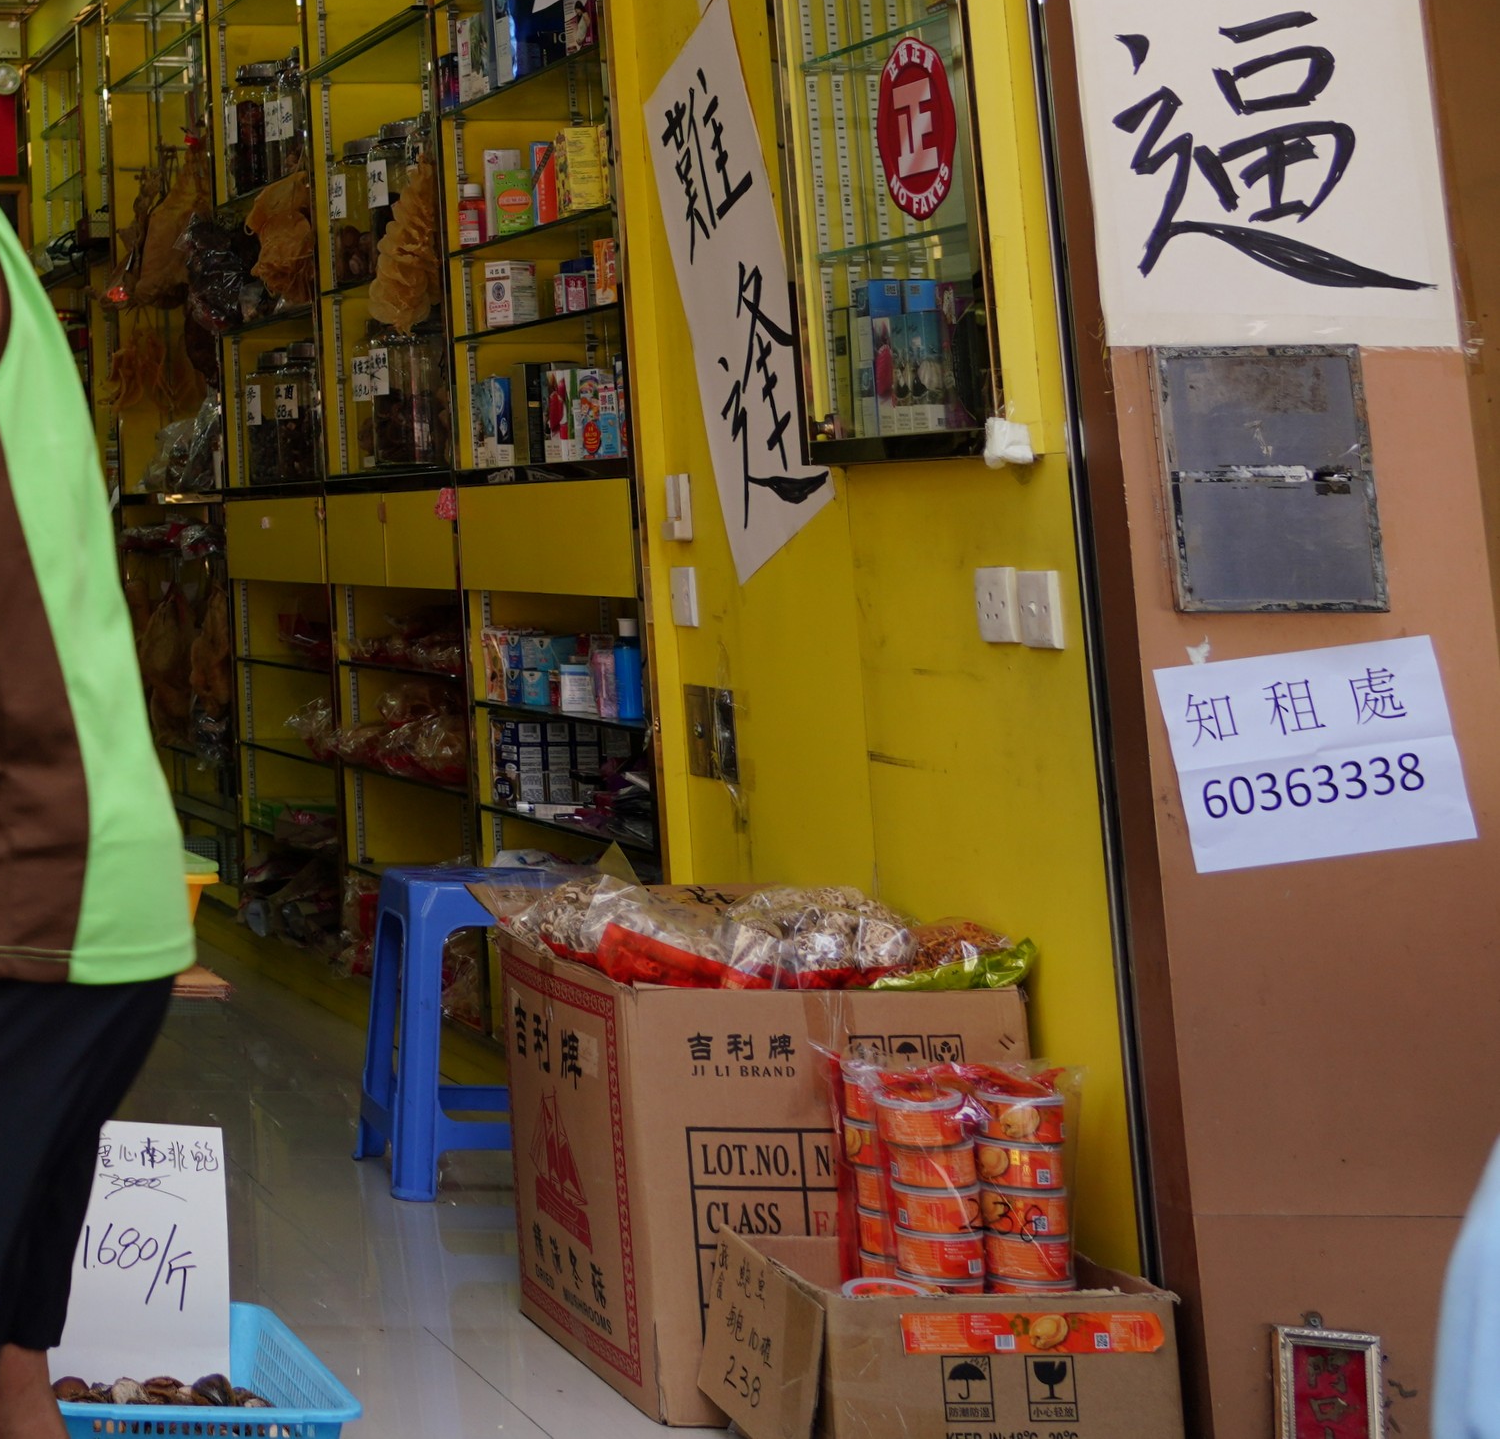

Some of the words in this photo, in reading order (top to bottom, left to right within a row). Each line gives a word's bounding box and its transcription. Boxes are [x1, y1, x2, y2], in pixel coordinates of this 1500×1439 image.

[891, 77, 939, 179] 正
[889, 172, 907, 207] NO
[912, 162, 951, 215] FAKES
[1183, 666, 1409, 749] 知租處
[1201, 752, 1426, 820] 60363338
[514, 996, 584, 1090] 吉利牌
[686, 1031, 796, 1062] 吉利牌
[691, 1065, 705, 1078] JI
[715, 1065, 731, 1078] LI
[740, 1064, 797, 1078] BRAND
[701, 1143, 798, 1177] LOT.NO.
[705, 1200, 782, 1237] CLASS
[958, 1197, 1043, 1244] 238
[723, 1355, 763, 1408] 238
